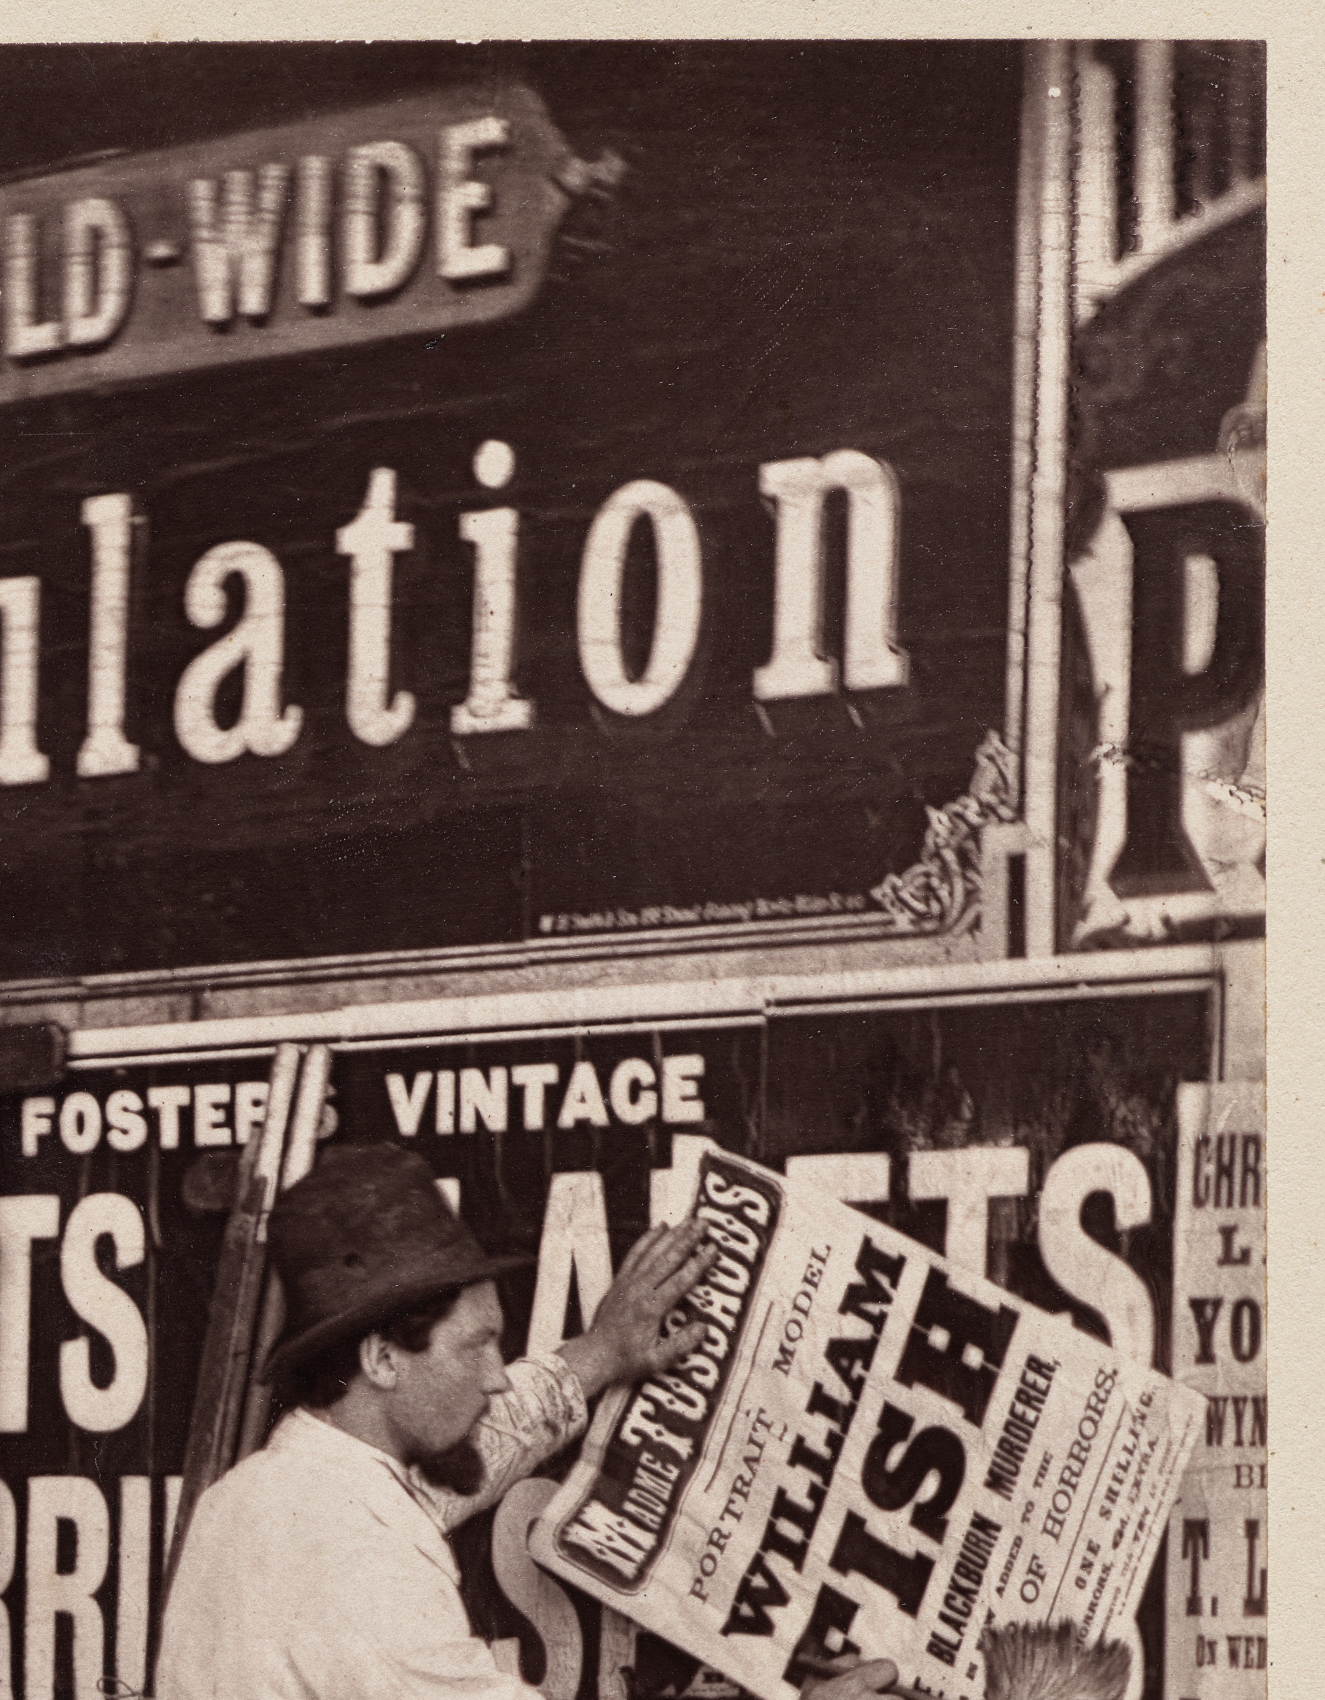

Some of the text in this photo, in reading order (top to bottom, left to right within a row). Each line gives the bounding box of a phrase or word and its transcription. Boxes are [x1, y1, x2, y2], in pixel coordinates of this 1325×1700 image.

[384, 1052, 706, 1138] VINTAGE
[687, 1406, 774, 1604] PORTRAIT
[770, 1244, 831, 1377] MODEL
[718, 1234, 907, 1637] WILLIAM
[780, 1262, 1023, 1691] FISH
[925, 1510, 1002, 1667] BLACKBURN
[982, 1353, 1060, 1501] MURDERER,
[1019, 1367, 1119, 1604] OF HORRORS.
[1020, 1499, 1035, 1524] TO
[1032, 1450, 1053, 1488] THE
[1073, 1538, 1101, 1590] ONE
